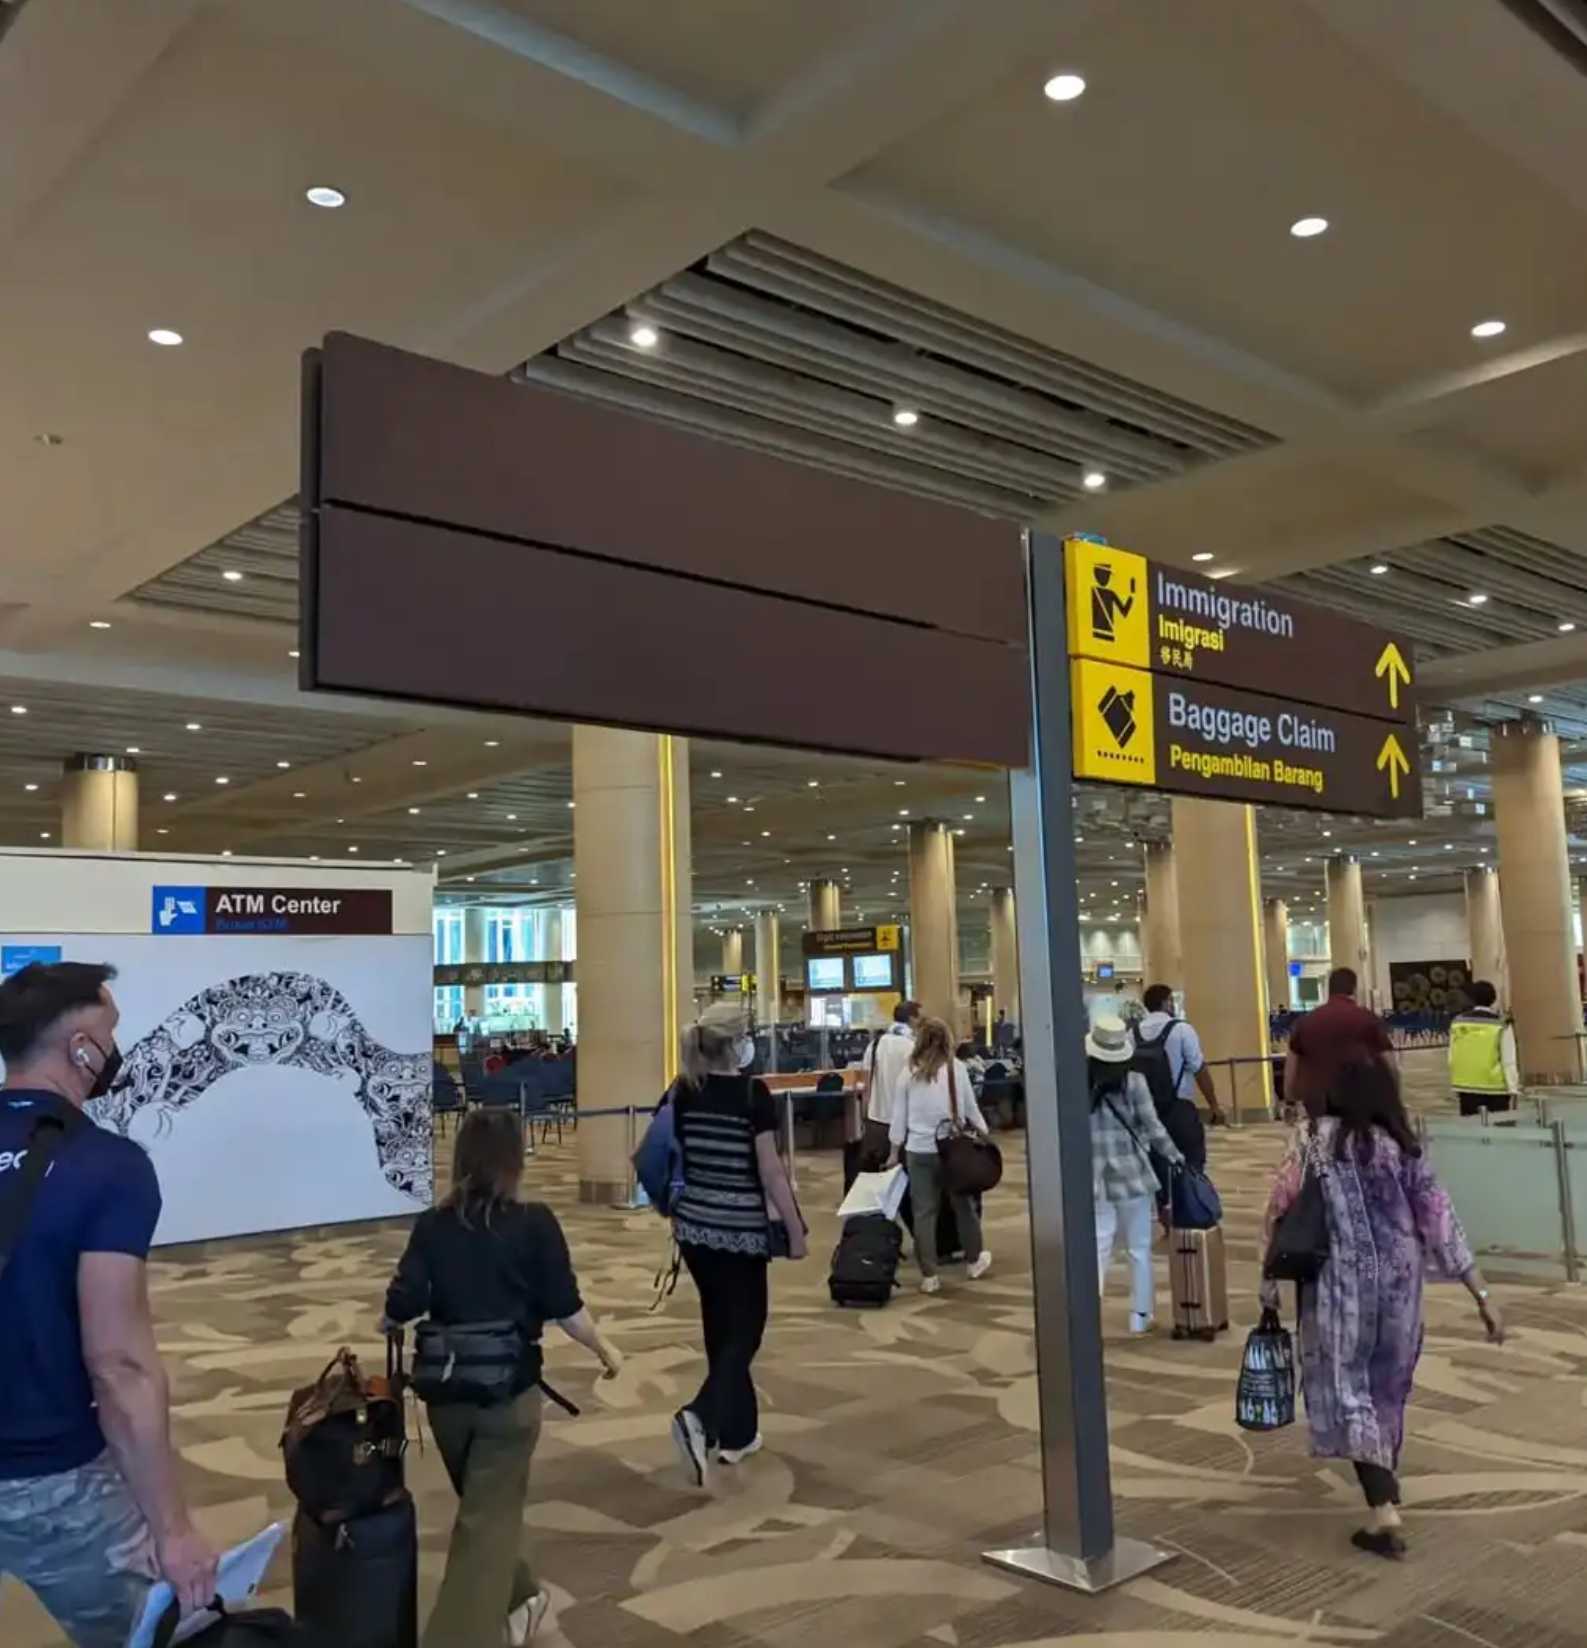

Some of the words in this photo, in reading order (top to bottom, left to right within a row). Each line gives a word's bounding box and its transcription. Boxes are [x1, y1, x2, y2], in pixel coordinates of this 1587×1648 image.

[1158, 572, 1293, 638] Immigration
[1158, 613, 1224, 652] Imigrasi
[1169, 692, 1272, 747] Baggage
[1278, 713, 1336, 752] Claim
[1170, 744, 1271, 780] Pengambilan
[1273, 759, 1324, 793] Barang
[215, 893, 264, 914] ATM
[271, 894, 342, 914] Center
